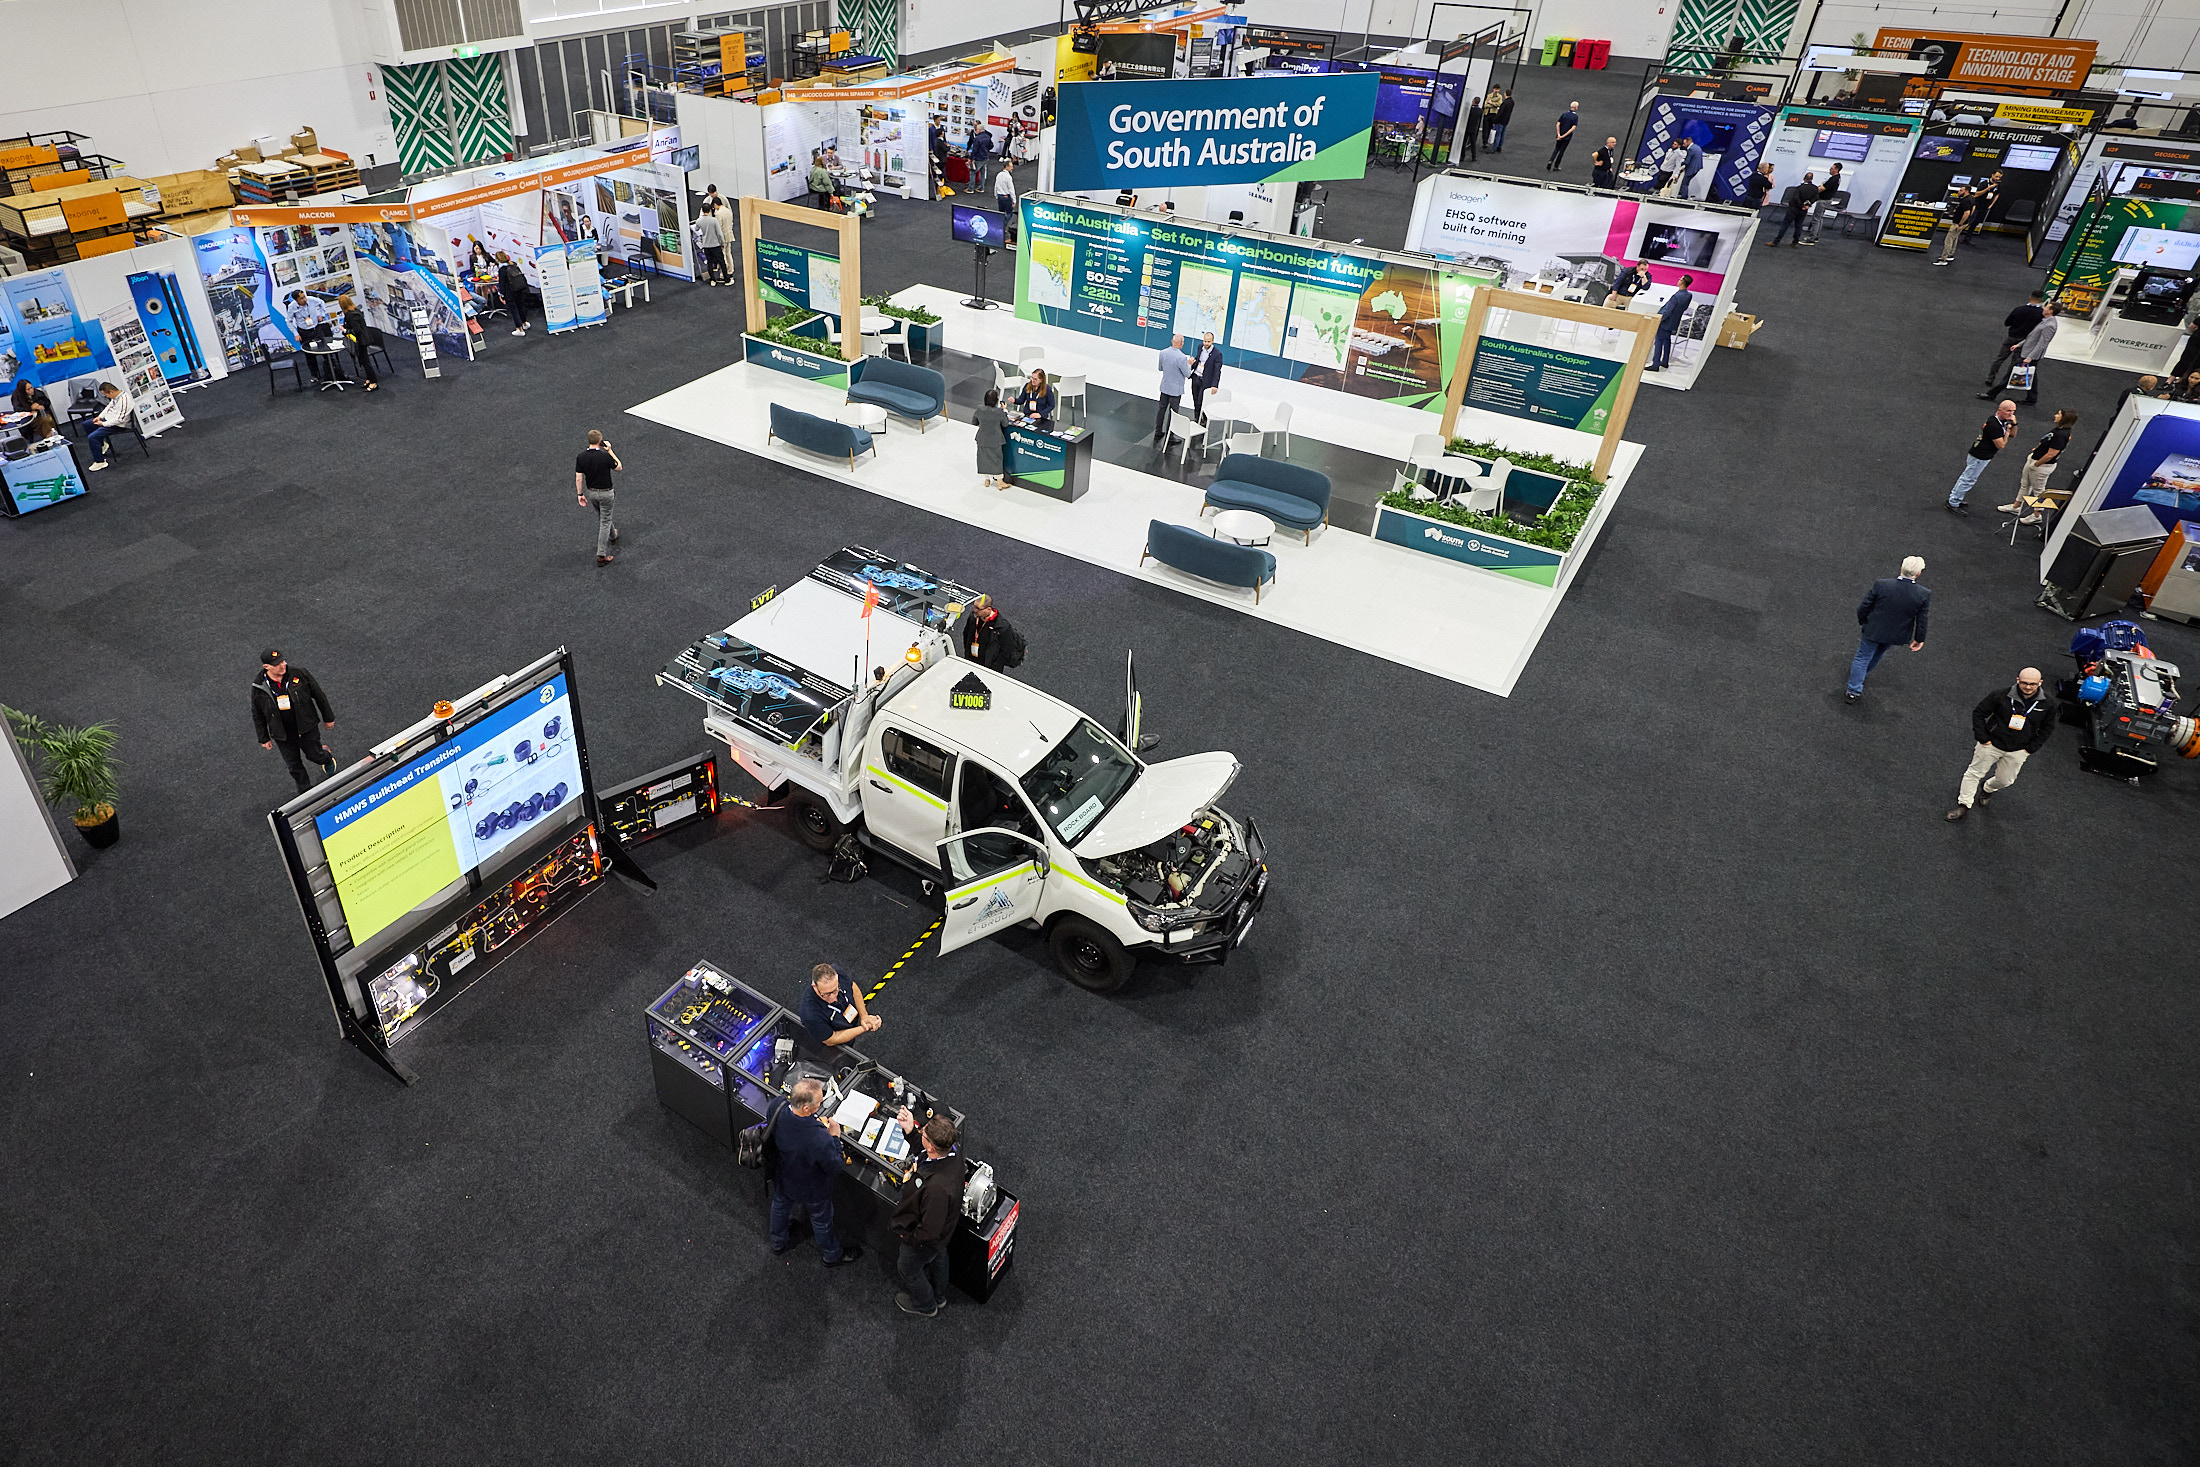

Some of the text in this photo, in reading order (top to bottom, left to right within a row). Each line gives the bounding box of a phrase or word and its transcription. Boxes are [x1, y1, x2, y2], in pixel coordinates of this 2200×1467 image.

[1967, 48, 2076, 68] TECHNOLOGY AND
[1960, 62, 2076, 84] INNOVATION STAGE
[1108, 96, 1325, 134] Government of
[1963, 104, 1994, 113] Fast2Mine
[2004, 105, 2086, 117] MINING MANAGEMENT
[1837, 121, 1869, 129] CONSULTING
[1891, 126, 1908, 134] AIMEX
[1946, 127, 1980, 138] MINING
[1988, 131, 2006, 140] THE
[2006, 134, 2044, 143] FUTURE
[1106, 132, 1317, 170] South Australia
[2154, 151, 2191, 160] GEOSECURE
[609, 158, 625, 169] RUBBER
[636, 152, 649, 160] AIMEX
[525, 179, 539, 187] AIMEX
[67, 207, 100, 219] exponet
[298, 211, 336, 219] MACKORN
[388, 209, 408, 217] AIMEX
[1445, 208, 1527, 229] EHSQ software
[1442, 221, 1526, 245] built for mining
[757, 241, 803, 257] South Australia's
[1033, 206, 1384, 281] South Australia Set for a decarbonised future
[758, 247, 779, 257] Copper
[771, 260, 785, 271] 68
[419, 268, 449, 301] MACKORN
[773, 278, 790, 290] 103
[1086, 270, 1104, 283] 50
[1083, 285, 1120, 302] $22bn
[1088, 302, 1113, 315] 74%
[1481, 339, 1591, 366] South Australia's Copper
[1442, 535, 1464, 546] SOUTH
[752, 588, 775, 610] LV17
[953, 693, 984, 708] LV1006
[334, 744, 462, 824] HMWS Bulkhead Transition
[339, 823, 406, 867] Product Description
